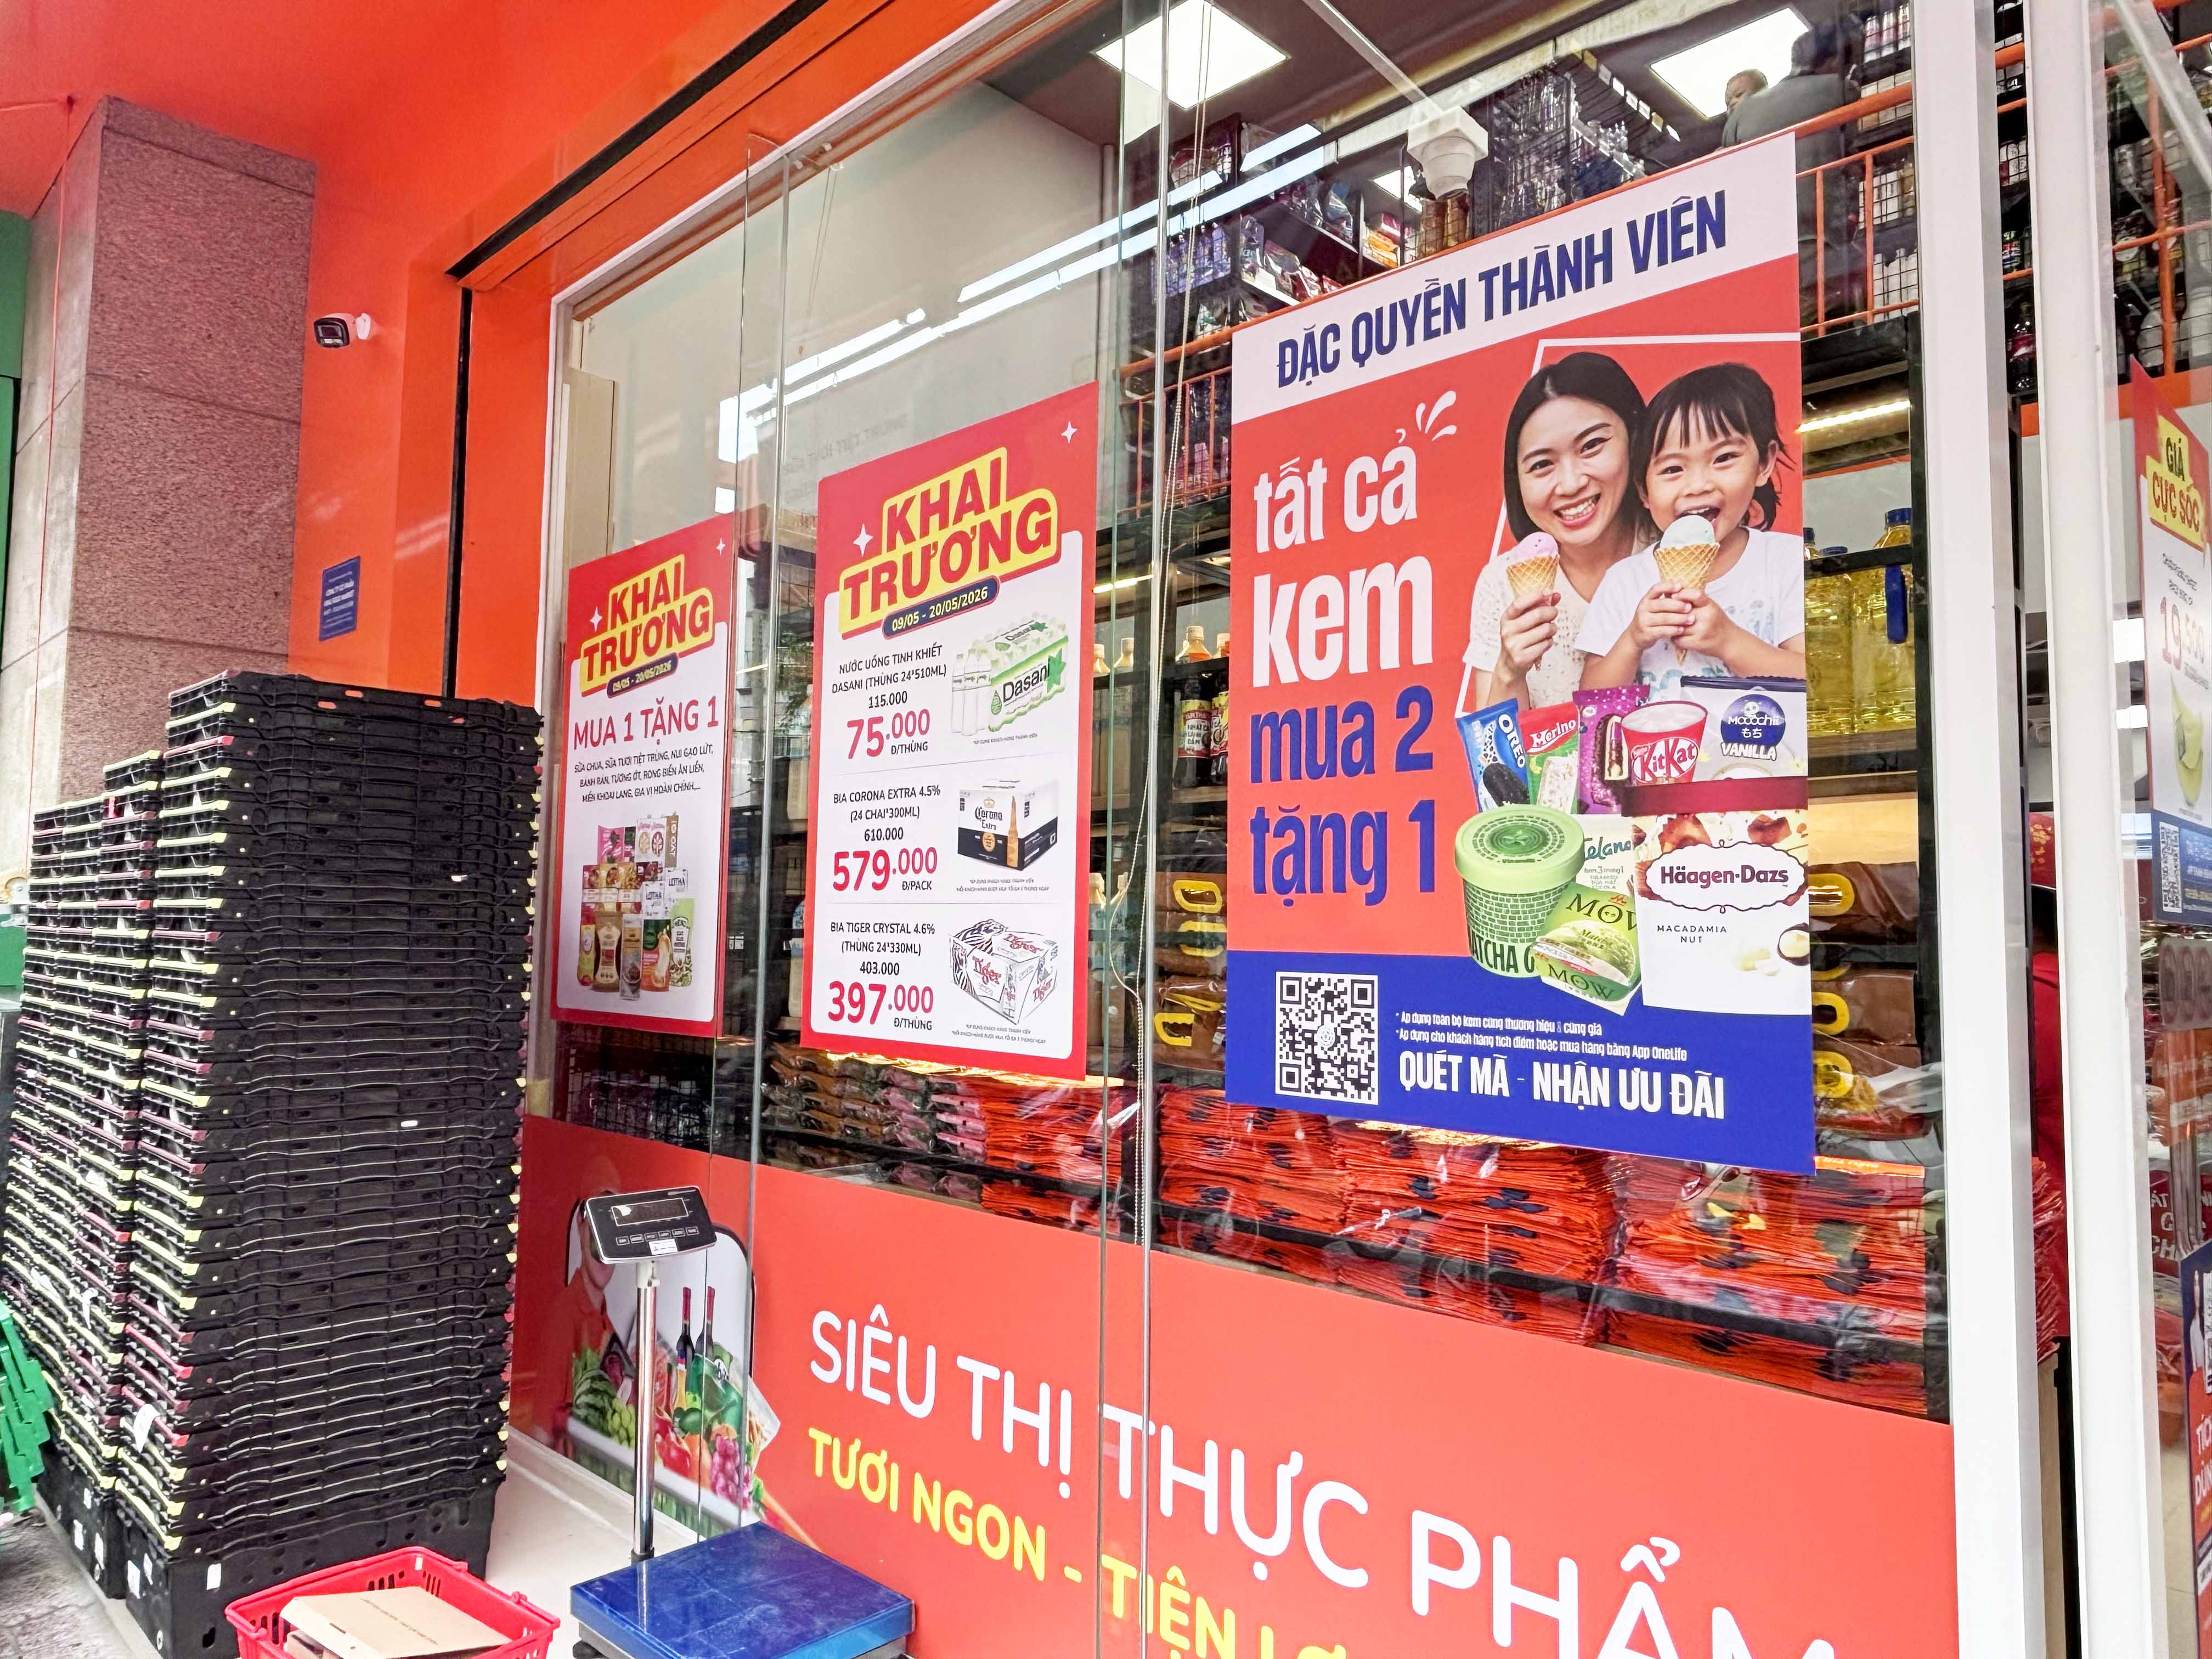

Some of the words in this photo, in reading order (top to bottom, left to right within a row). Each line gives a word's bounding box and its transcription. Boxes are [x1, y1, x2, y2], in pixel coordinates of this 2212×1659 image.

[1277, 324, 1340, 387] ĐẶC
[1352, 278, 1465, 368] QUYỀN
[1479, 228, 1613, 321] THÀNH
[1627, 190, 1726, 274] VIÊN
[2166, 437, 2185, 482] GIÁ
[887, 456, 1001, 554] KHAI
[1254, 456, 1327, 553] tất
[1344, 429, 1417, 533] cả
[844, 498, 1052, 620] TRƯƠNG
[610, 561, 681, 630] KHAI
[892, 613, 919, 632] 09/05
[929, 586, 989, 619] 20/05/2026
[583, 594, 710, 681] TRƯƠNG
[1253, 556, 1432, 687] kem
[839, 655, 862, 675] NƯỚC
[865, 650, 890, 670] UỐNG
[893, 649, 913, 665] TINH
[915, 643, 943, 661] KHIẾT
[832, 679, 863, 694] DASANI
[865, 669, 899, 691] (THÙNG
[868, 691, 908, 709] 115.000
[1003, 659, 1049, 703] Dasani
[574, 715, 616, 750] MUA
[623, 712, 634, 742] 1
[640, 696, 699, 745] TẶNG
[707, 695, 719, 727] 1
[847, 708, 930, 760] 75.000
[1251, 700, 1375, 783] mua
[1395, 685, 1433, 772] 2
[1498, 714, 1525, 768] OREO
[1742, 727, 1762, 738] もち
[890, 738, 928, 756] Đ/THÙNG
[1638, 738, 1696, 781] KitKat
[1720, 742, 1776, 761] VANILLA
[833, 793, 847, 804] BIA
[849, 790, 885, 802] CORONA
[888, 787, 917, 800] EXTRA
[918, 785, 940, 798] 4.5%
[864, 827, 904, 842] 610.000
[1250, 804, 1387, 906] tặng
[1408, 799, 1435, 893] 1
[833, 847, 938, 892] 579.000
[901, 880, 933, 891] Đ/PACK
[1661, 865, 1789, 889] Häagen-Dazs
[831, 923, 844, 933] BIA
[846, 922, 871, 933] TIGER
[873, 923, 911, 934] CRYSTAL
[913, 923, 935, 935] 4.6%
[842, 938, 874, 953] (THÙNG
[1657, 925, 1726, 933] MACADAMIA
[860, 961, 900, 976] 403.000
[1470, 930, 1519, 973] ATCHA
[828, 980, 934, 1025] 397.000
[1549, 963, 1616, 1000] MOW
[894, 1015, 933, 1031] Đ/THÙNG
[1463, 1015, 1481, 1028] kem
[1431, 1030, 1445, 1043] cho
[1560, 1041, 1580, 1053] mua
[1632, 1045, 1650, 1060] App
[1400, 1049, 1462, 1092] QUÉT
[1470, 1053, 1510, 1097] MÃ
[1533, 1060, 1610, 1110] NHẬN
[1618, 1067, 1661, 1113] ƯU
[1669, 1070, 1724, 1120] ĐÃI
[810, 1303, 937, 1419] SIÊU
[957, 1355, 1073, 1499] THỊ
[1101, 1402, 1369, 1588] THỰC
[808, 1427, 899, 1513] TƯƠI
[913, 1471, 1046, 1582] NGON
[1101, 1554, 1236, 1659] TIỆN
